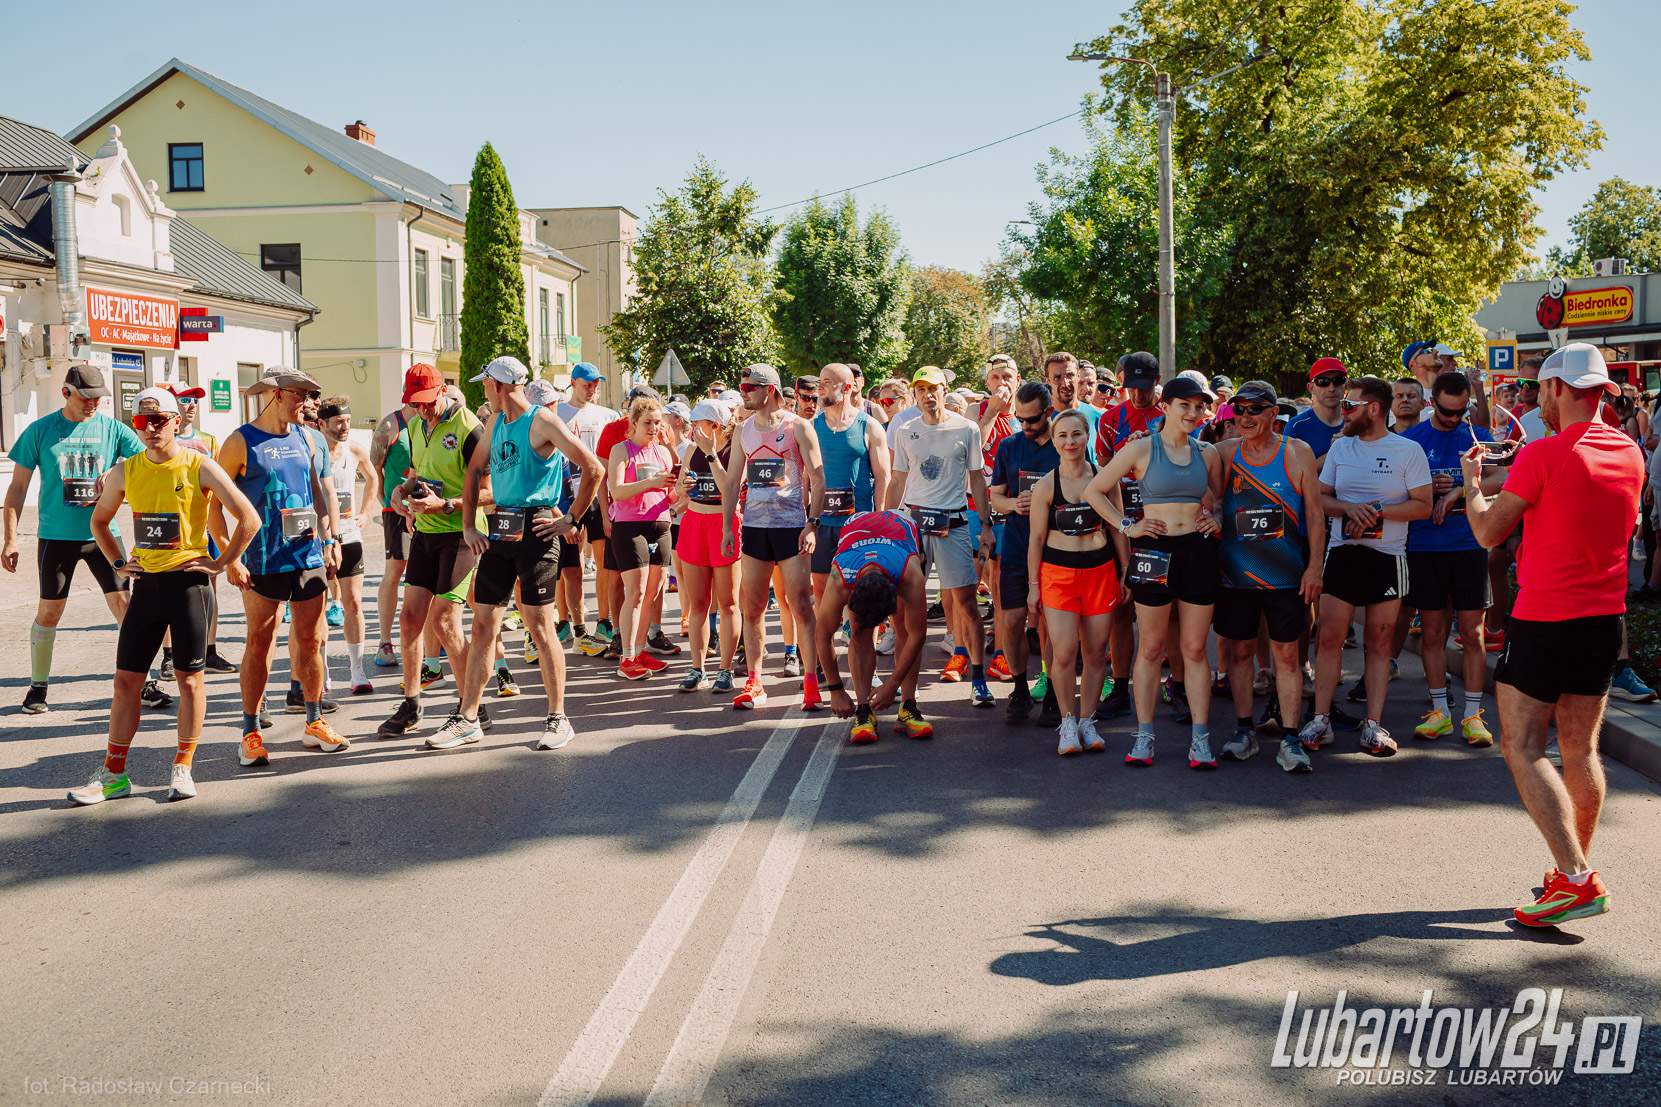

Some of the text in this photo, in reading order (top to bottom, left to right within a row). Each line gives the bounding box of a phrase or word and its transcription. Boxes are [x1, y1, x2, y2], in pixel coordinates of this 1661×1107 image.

[1567, 294, 1628, 312] Biedronka
[90, 293, 177, 329] UBEZPIECZENIA
[100, 327, 110, 338] OC
[112, 327, 120, 339] AC
[152, 331, 160, 344] Na
[1495, 348, 1509, 368] P
[758, 469, 772, 479] 46
[74, 488, 95, 497] 116
[698, 482, 715, 492] 105
[828, 497, 842, 507] 94
[297, 519, 310, 530] 93
[498, 519, 510, 530] 28
[921, 516, 935, 526] 78
[1075, 514, 1084, 525] 4
[1251, 517, 1268, 529] 76
[146, 526, 163, 537] 24
[1137, 561, 1152, 573] 60
